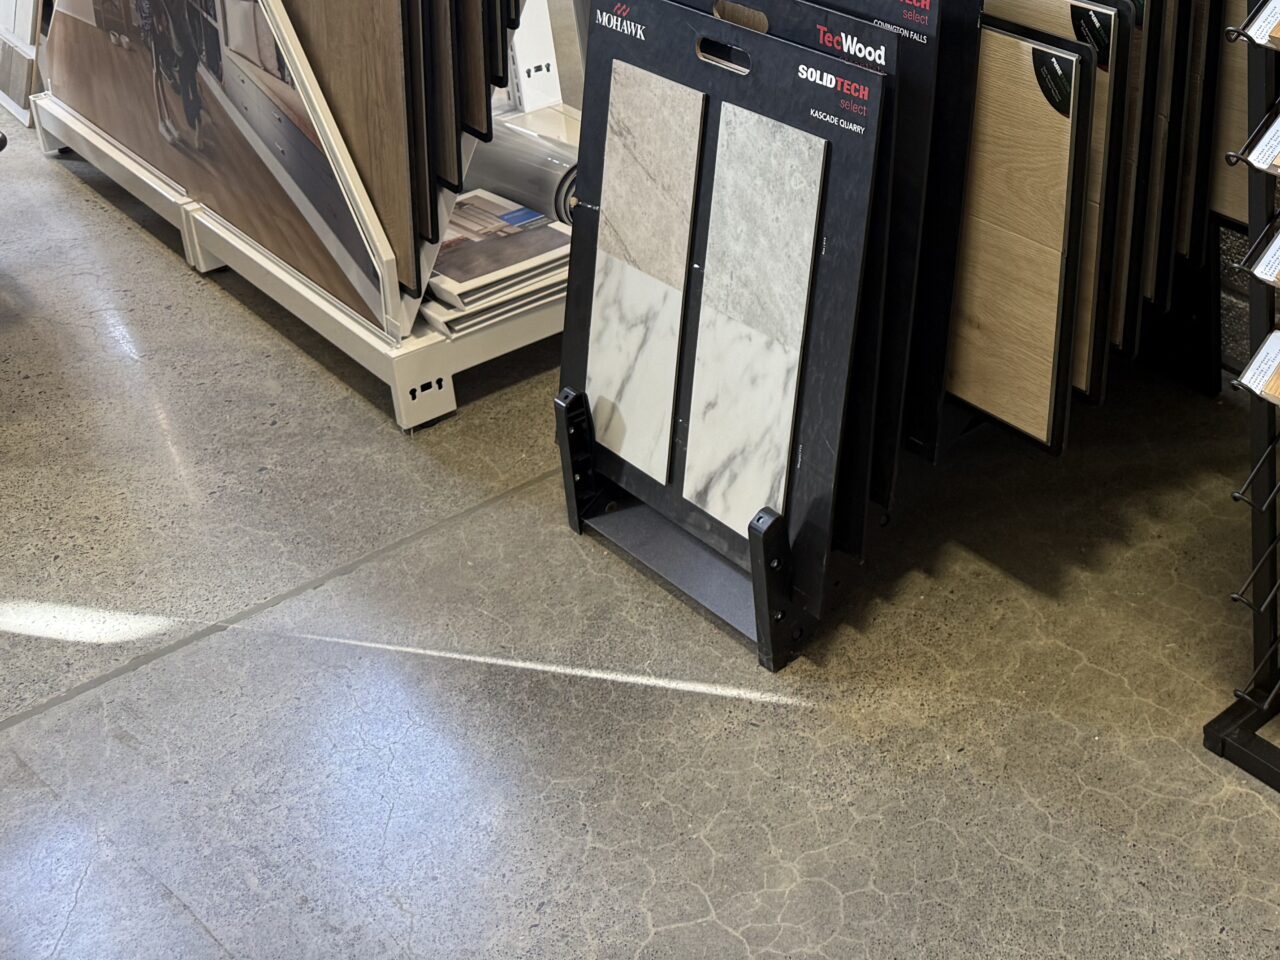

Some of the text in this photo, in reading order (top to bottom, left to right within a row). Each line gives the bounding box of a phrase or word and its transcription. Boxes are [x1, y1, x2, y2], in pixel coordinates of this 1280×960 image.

[596, 9, 646, 41] MOHAWK
[873, 19, 928, 44] COVINGTON FALLS
[902, 9, 929, 26] select
[816, 24, 886, 65] TecWood
[798, 64, 869, 101] SOLIDTECH
[840, 98, 867, 117] select
[810, 108, 866, 136] KASCADE QUARRY
